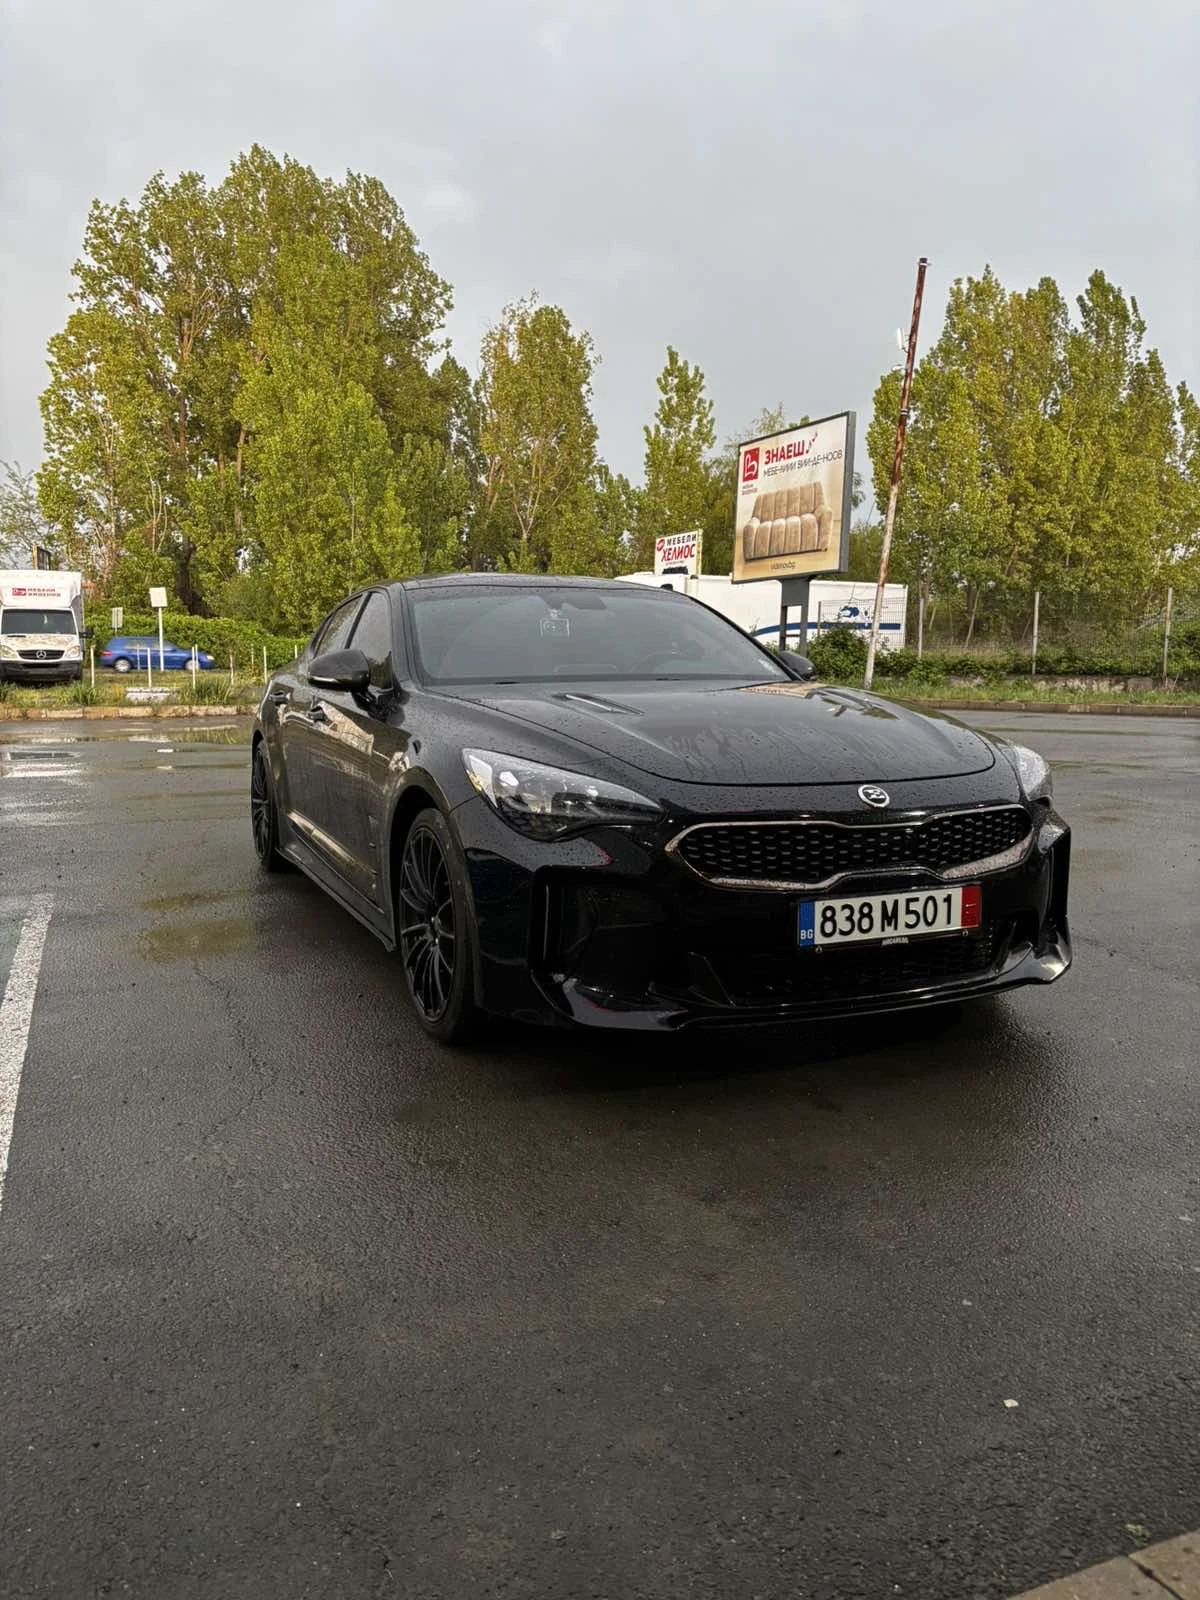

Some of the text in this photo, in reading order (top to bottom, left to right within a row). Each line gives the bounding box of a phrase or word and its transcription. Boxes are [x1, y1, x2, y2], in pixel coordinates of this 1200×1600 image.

[667, 533, 697, 546] МЕБЕЛИ
[661, 543, 696, 562] ХЕЛИОС
[820, 893, 953, 938] 838 M 501
[800, 928, 814, 940] BG
